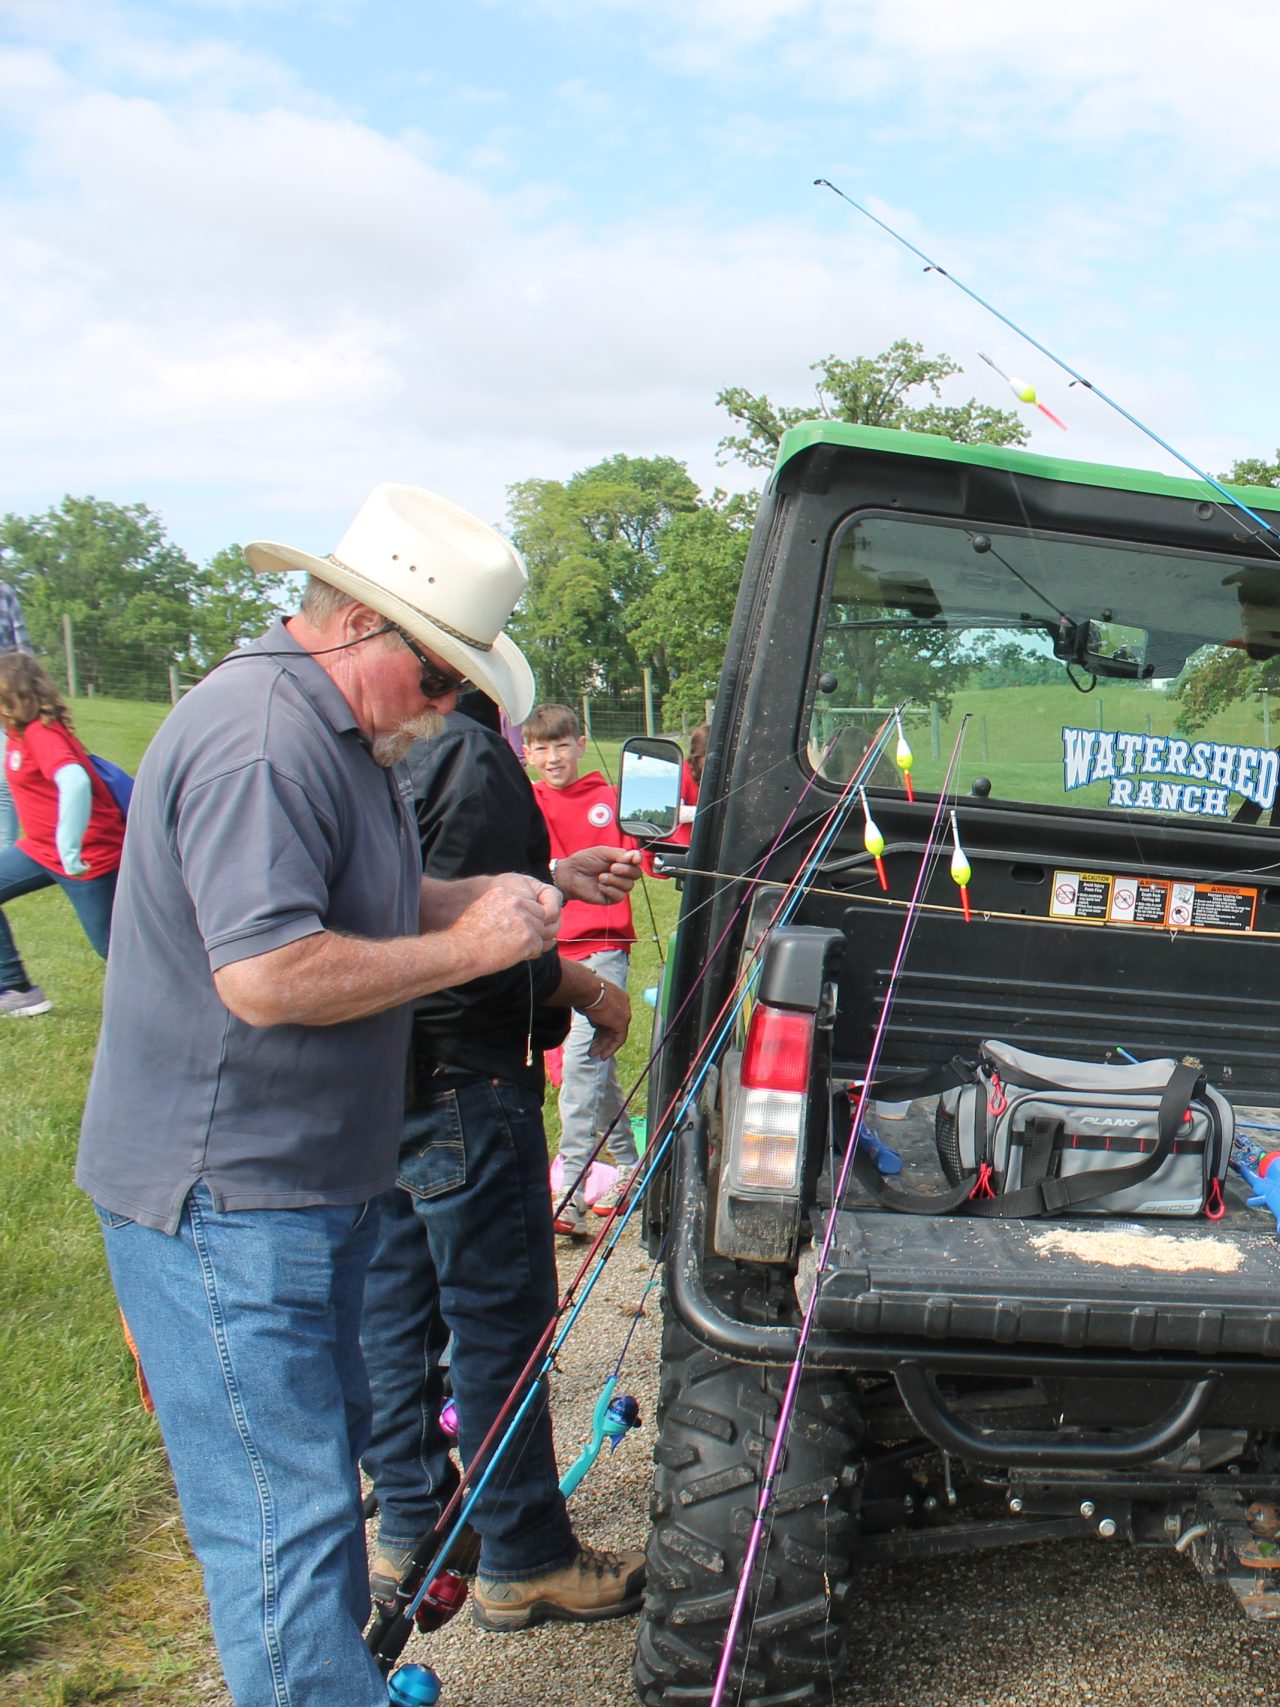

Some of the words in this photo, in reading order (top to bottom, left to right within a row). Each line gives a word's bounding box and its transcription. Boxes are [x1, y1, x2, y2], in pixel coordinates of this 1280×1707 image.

[1062, 727, 1279, 808] WATERSHED
[1108, 777, 1229, 816] RANCH
[1088, 874, 1109, 882] CAUTION
[1080, 1117, 1138, 1128] PLANO
